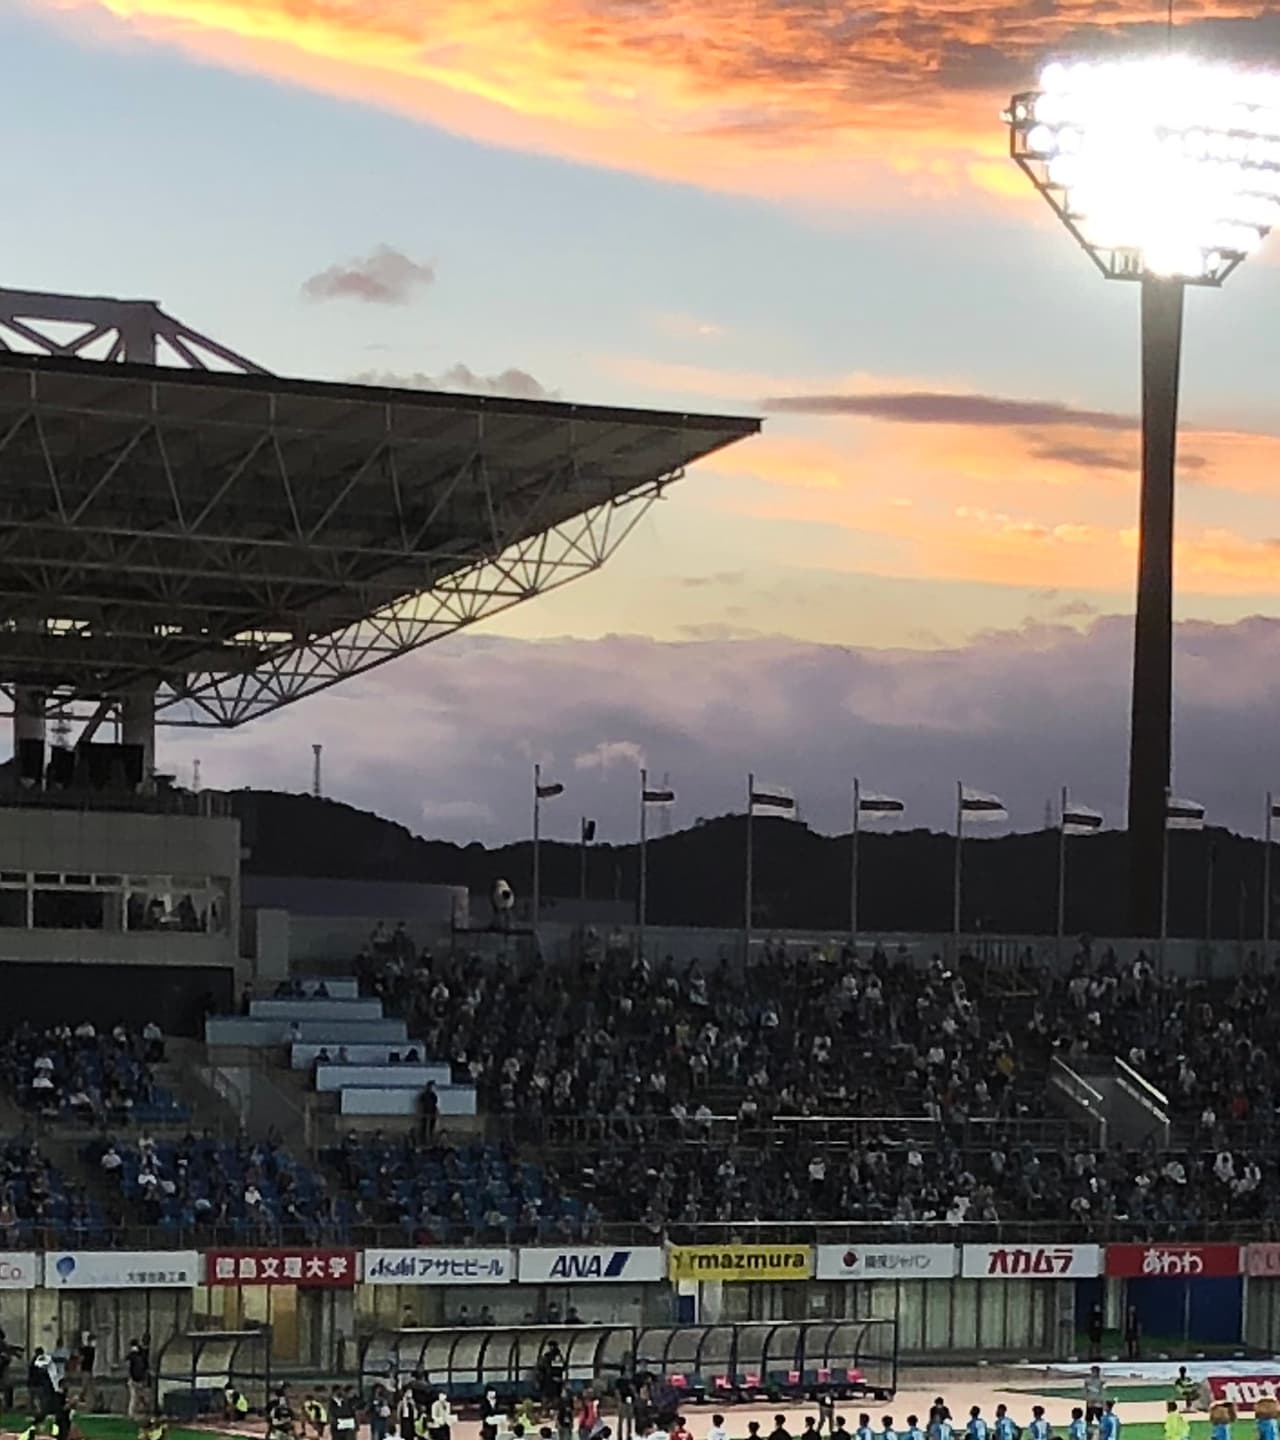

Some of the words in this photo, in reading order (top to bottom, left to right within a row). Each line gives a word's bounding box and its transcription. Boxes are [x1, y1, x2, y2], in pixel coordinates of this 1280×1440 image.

[215, 1256, 348, 1279] 徳島文理大学
[418, 1258, 505, 1277] アサヒビール
[550, 1255, 601, 1278] ANA
[988, 1248, 1073, 1274] オカムラ
[1142, 1248, 1203, 1273] あわわ
